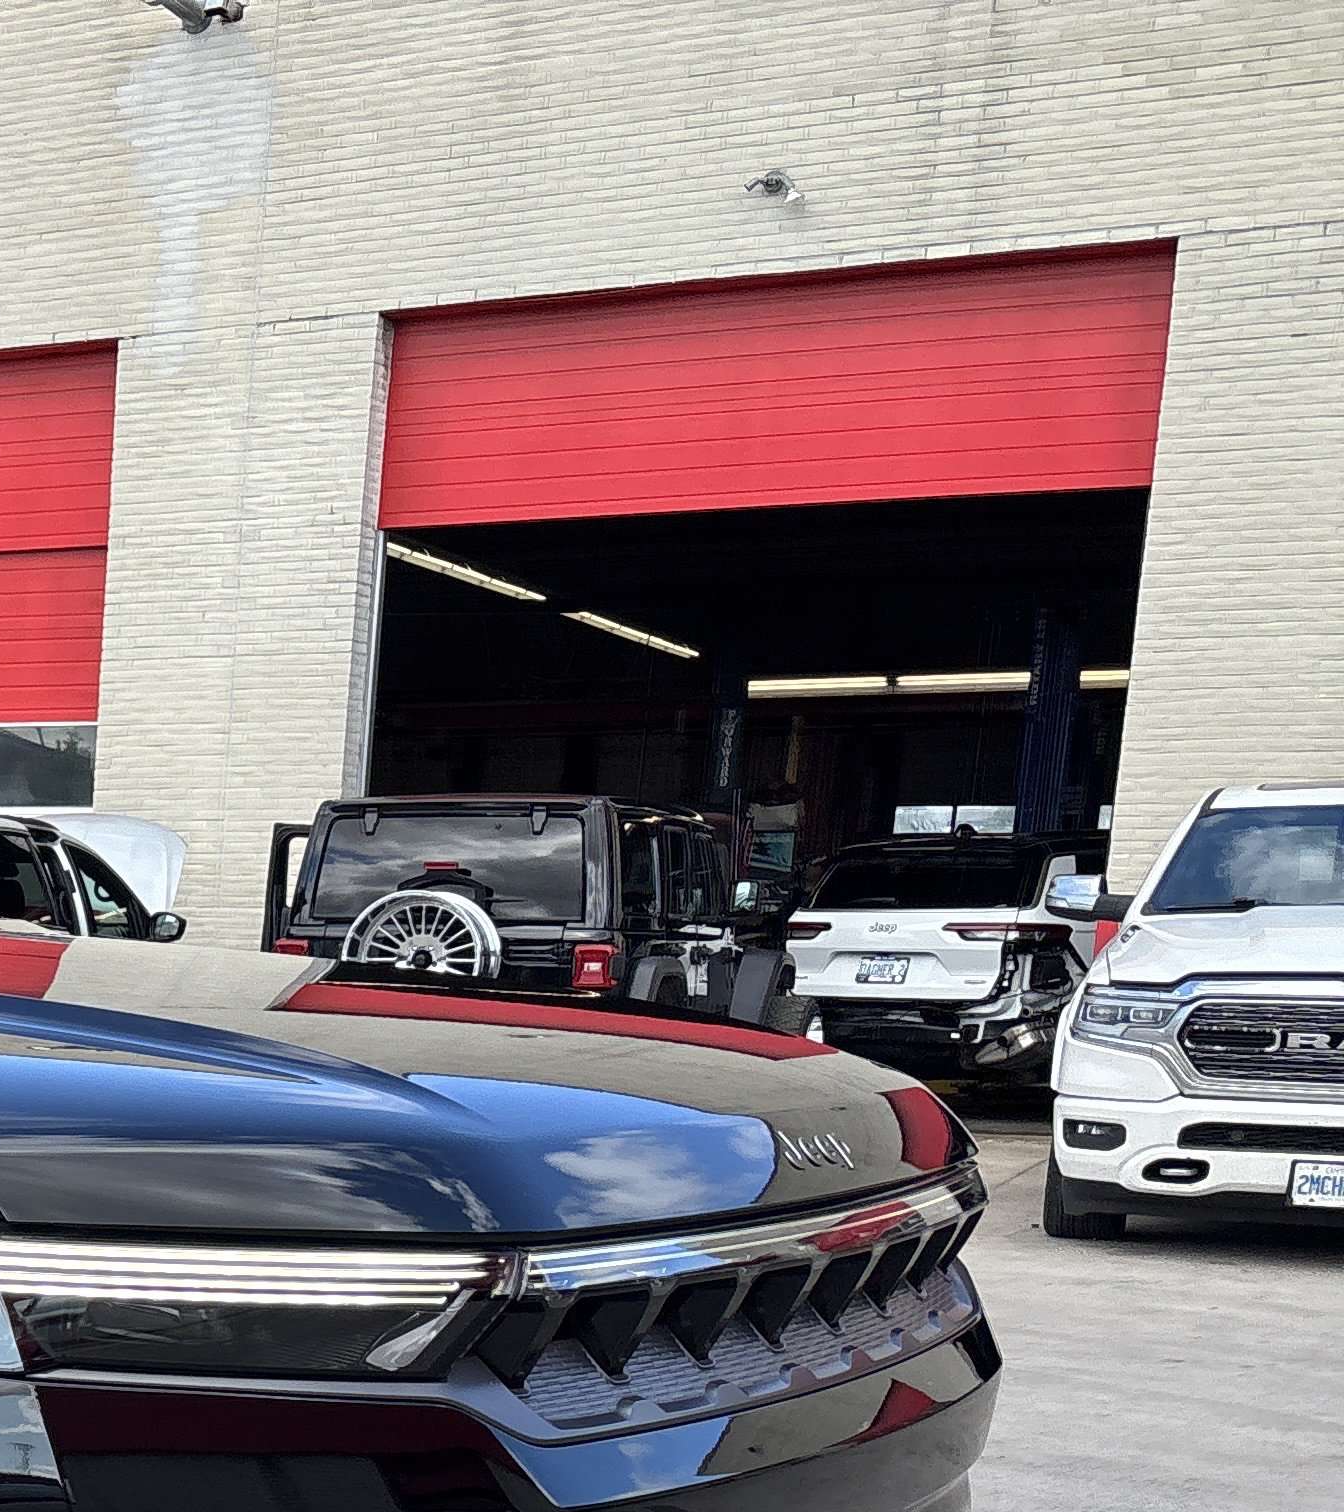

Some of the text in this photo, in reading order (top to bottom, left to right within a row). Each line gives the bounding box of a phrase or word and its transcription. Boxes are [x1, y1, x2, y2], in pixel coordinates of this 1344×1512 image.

[869, 922, 897, 934] Jeep
[777, 1131, 854, 1170] Jeep
[1297, 1174, 1344, 1196] 2MCH
